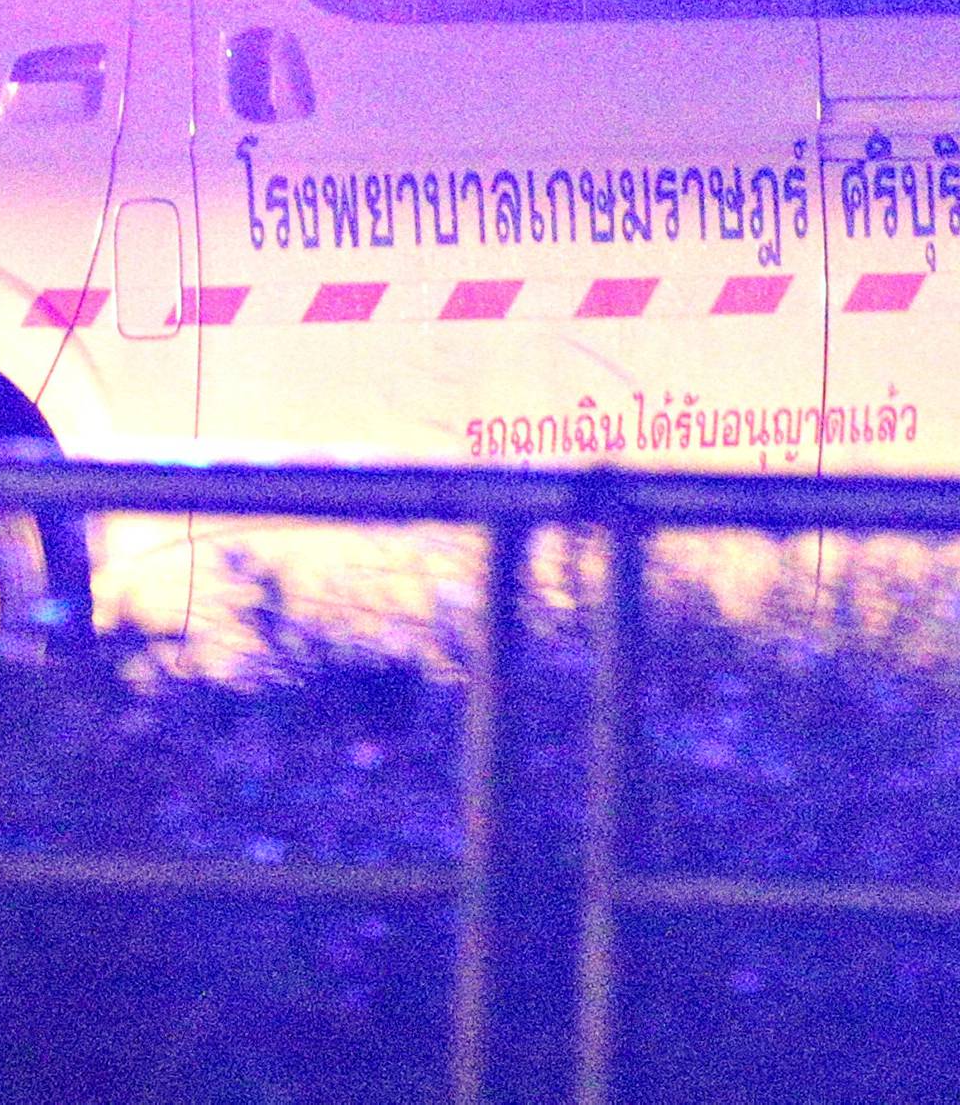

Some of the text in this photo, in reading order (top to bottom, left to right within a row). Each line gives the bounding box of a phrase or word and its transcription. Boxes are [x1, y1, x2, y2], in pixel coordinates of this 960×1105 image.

[236, 135, 810, 268] โรงพยาบาลเกษมราษฎร์
